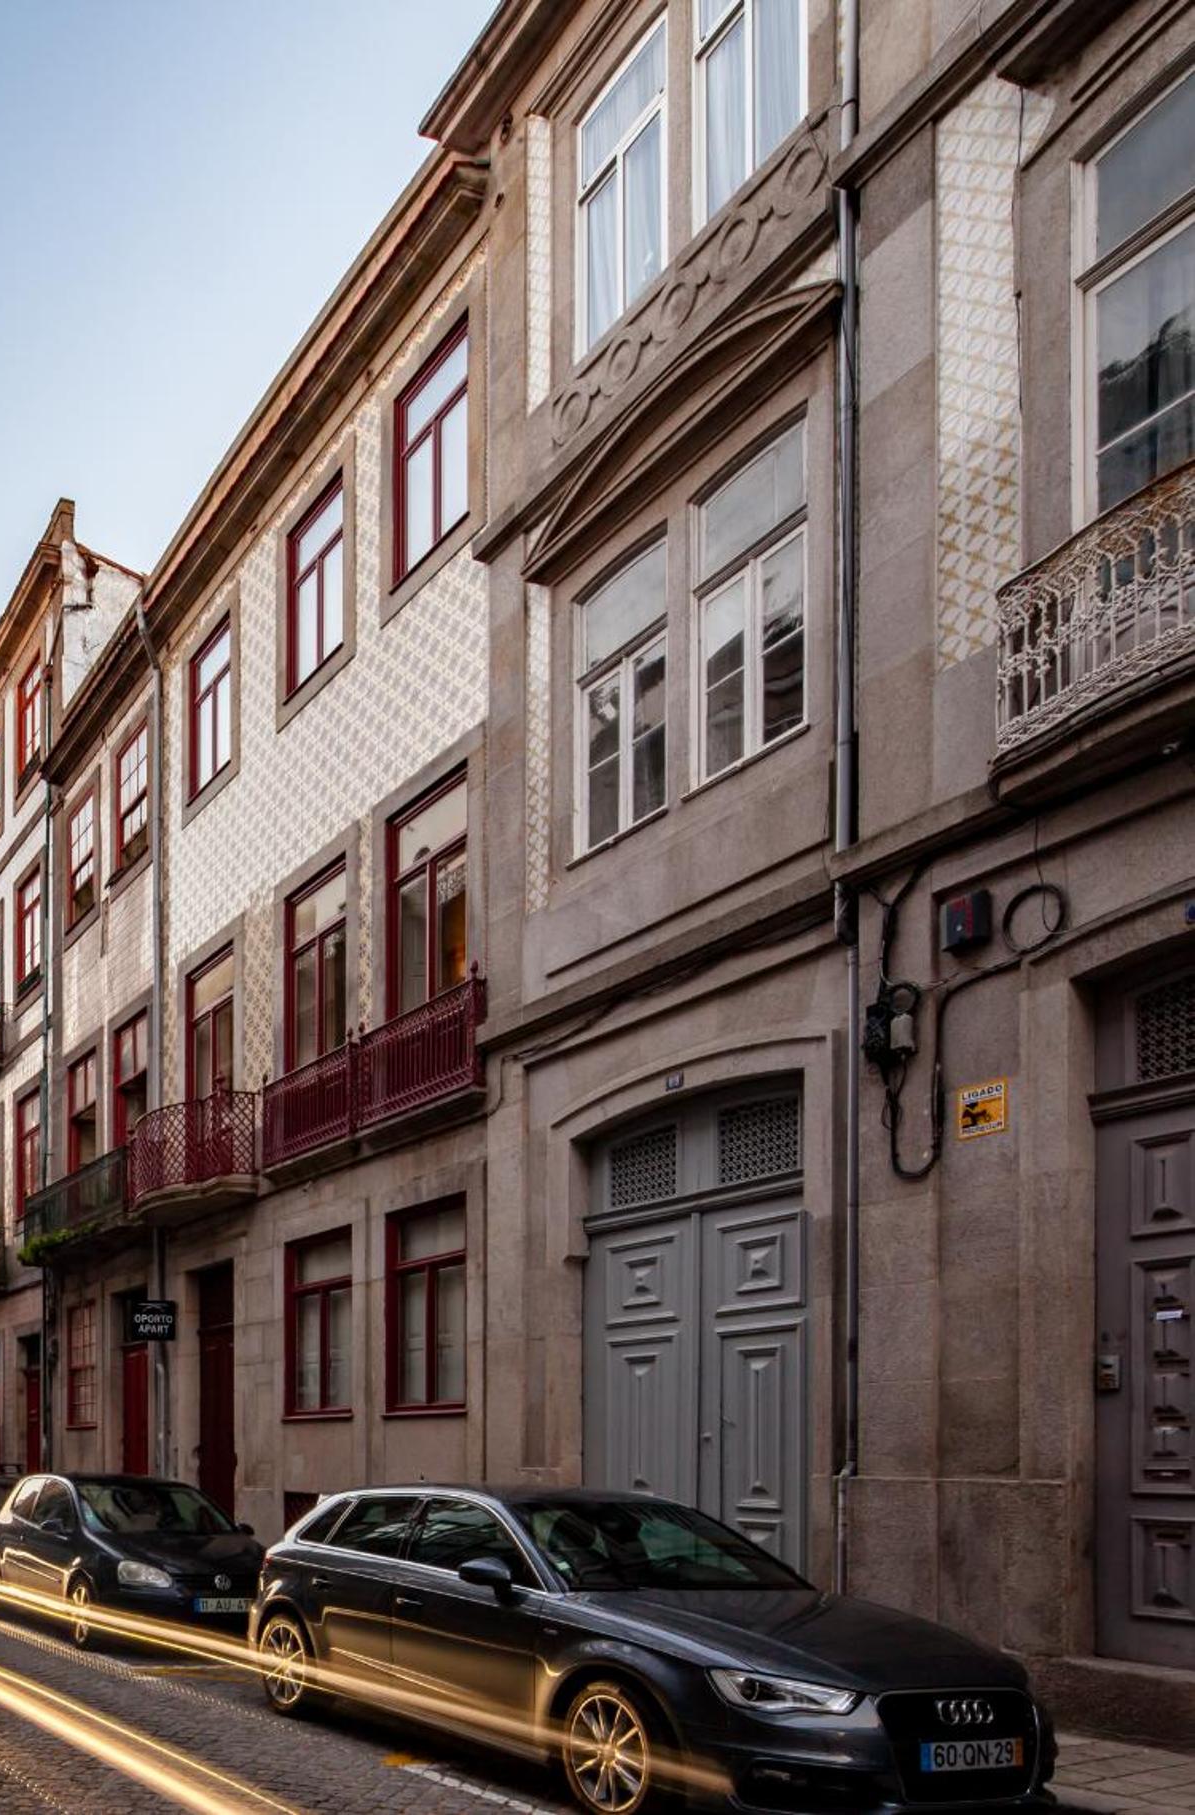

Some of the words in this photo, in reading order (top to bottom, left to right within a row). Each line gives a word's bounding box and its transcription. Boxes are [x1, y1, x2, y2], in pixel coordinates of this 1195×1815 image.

[961, 1084, 1003, 1100] LIGADO
[134, 1313, 173, 1324] OPORTO
[138, 1324, 169, 1334] APART
[934, 1741, 1013, 1768] 60-QN-29
